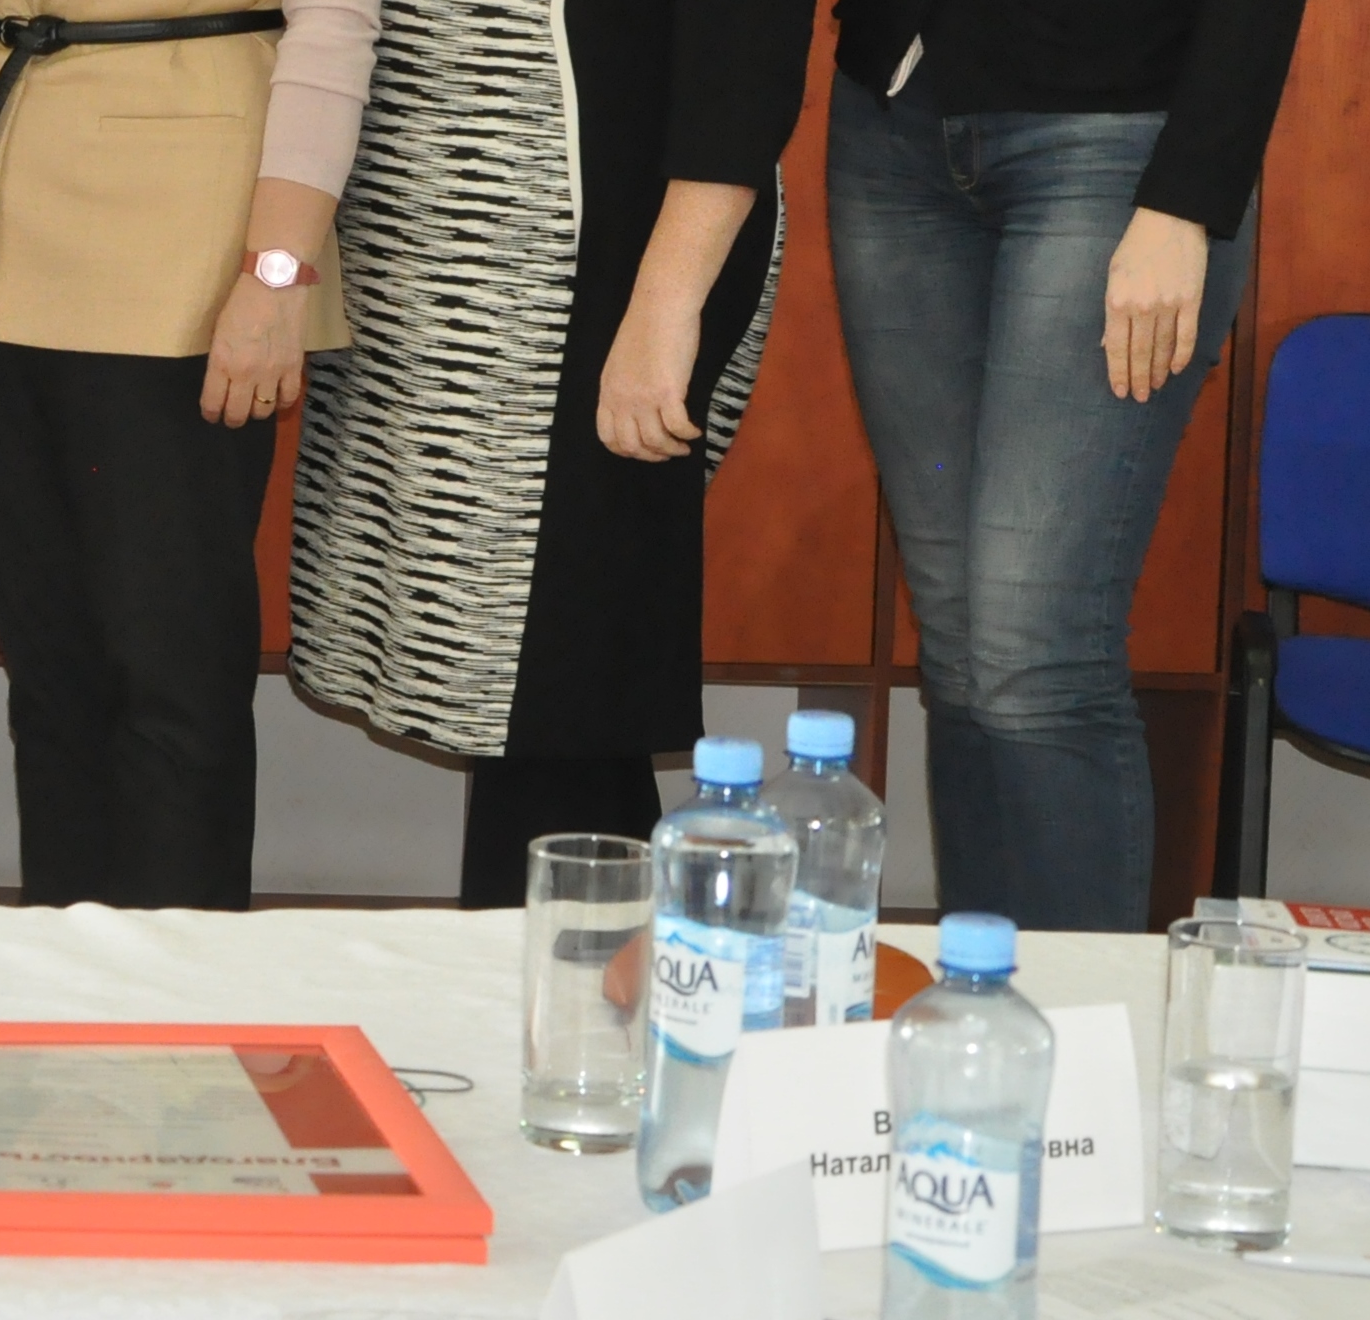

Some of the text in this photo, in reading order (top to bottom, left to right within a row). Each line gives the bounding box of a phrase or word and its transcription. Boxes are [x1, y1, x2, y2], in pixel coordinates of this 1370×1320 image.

[653, 955, 718, 996] QUA
[810, 1152, 892, 1178] Натал
[895, 1159, 995, 1215] AQUA
